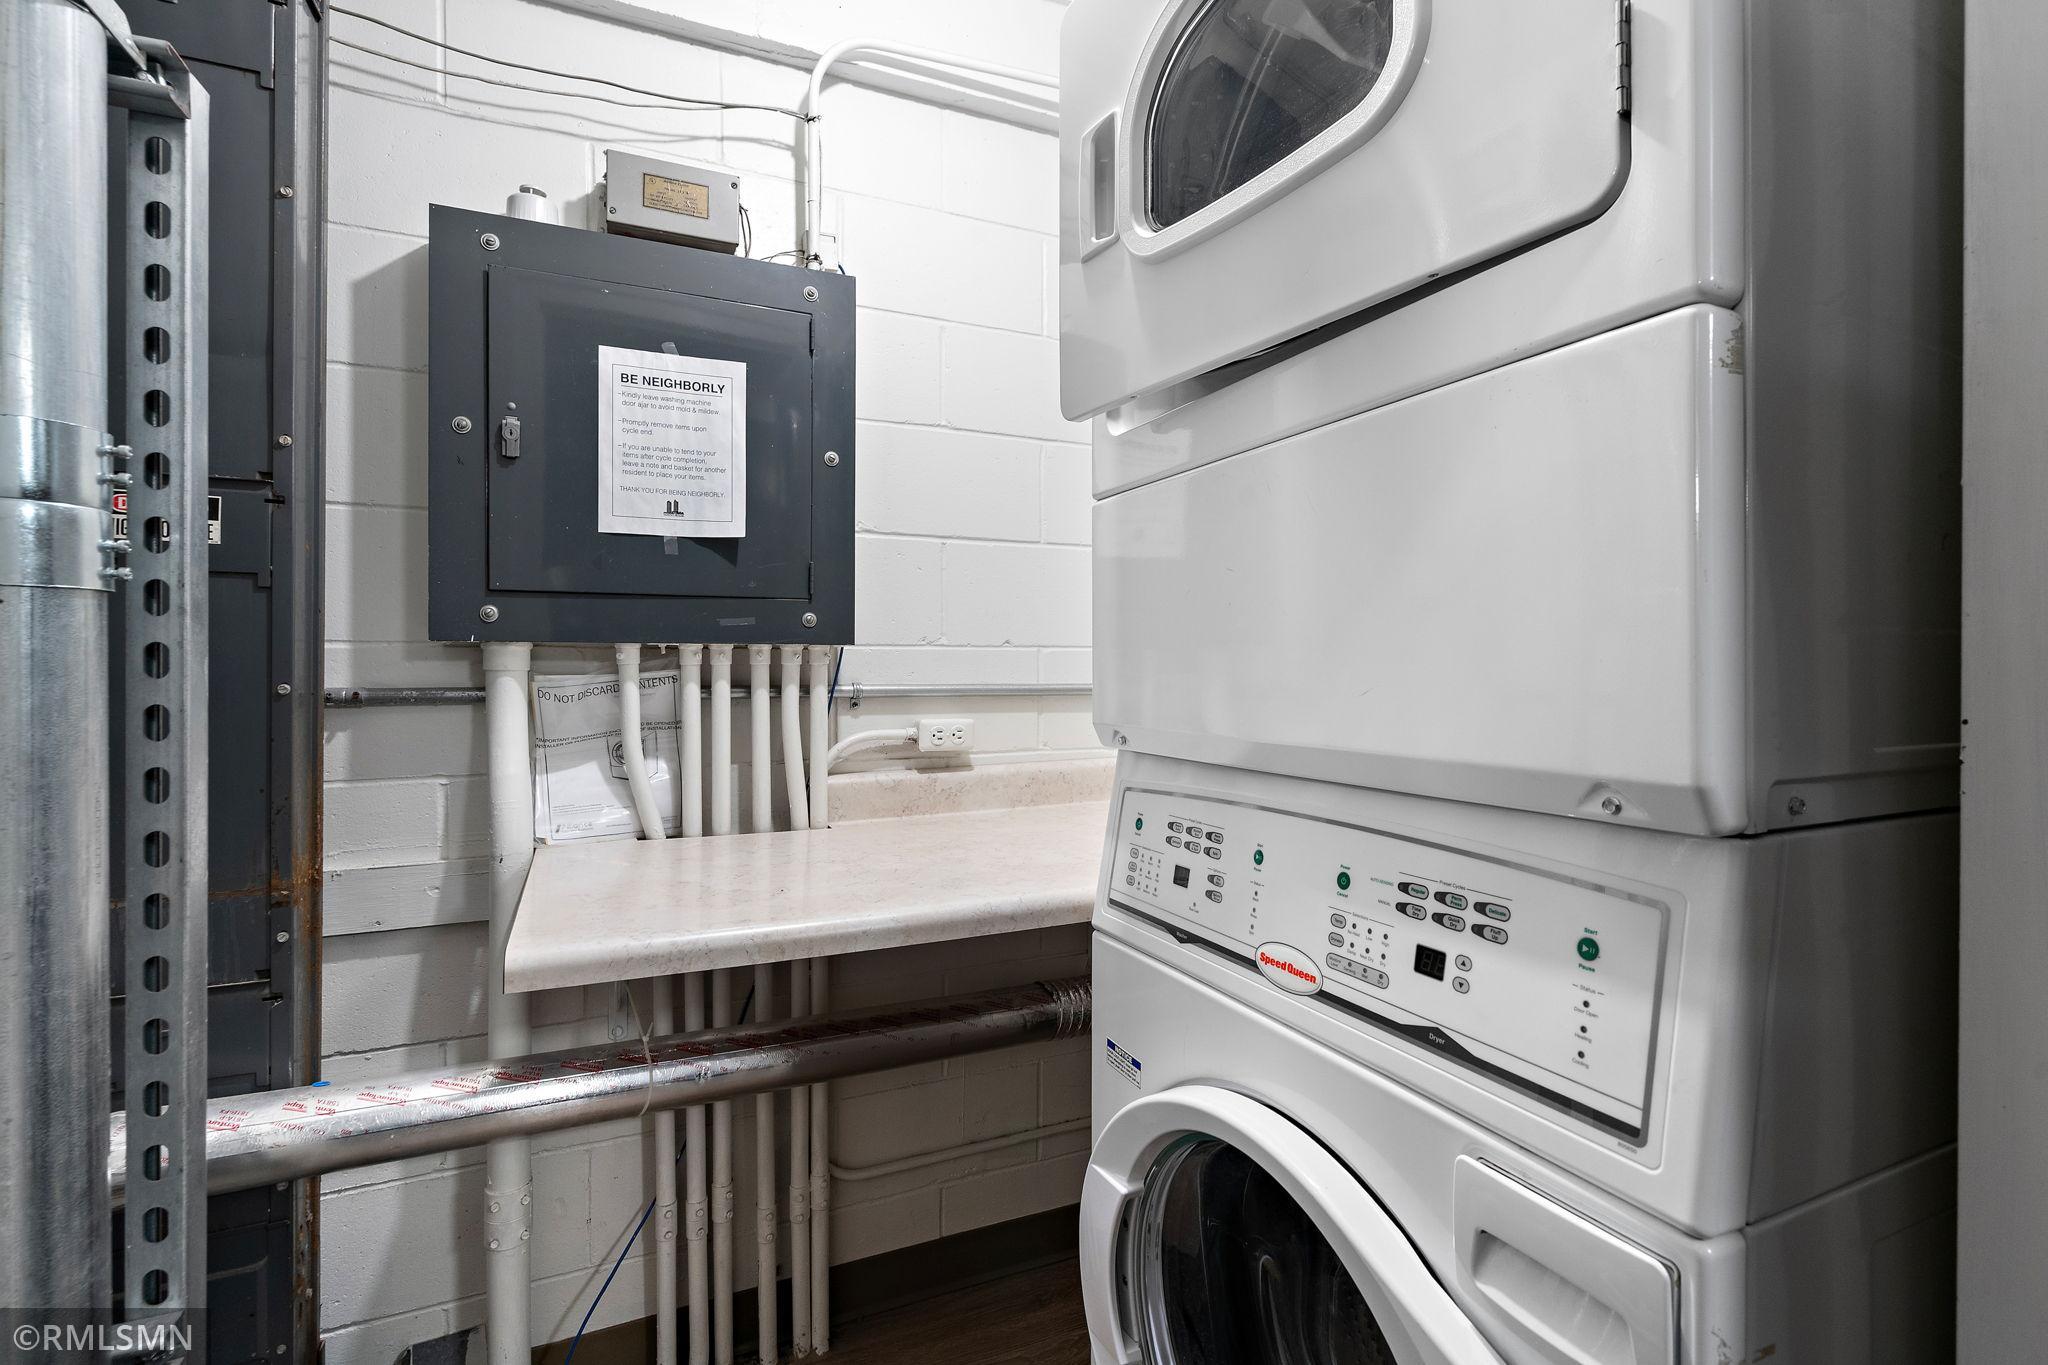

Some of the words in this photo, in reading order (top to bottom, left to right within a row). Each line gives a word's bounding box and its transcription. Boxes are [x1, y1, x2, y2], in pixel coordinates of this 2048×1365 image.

[620, 372, 639, 385] BE
[642, 375, 726, 395] NEIGHBORLY
[621, 400, 637, 408] door
[637, 402, 650, 410] ajar
[642, 393, 660, 401] leave
[660, 396, 685, 405] washing
[686, 399, 712, 407] machine
[621, 428, 639, 436] cycle
[650, 421, 673, 429] remove
[674, 423, 691, 431] items
[627, 444, 640, 452] you
[652, 446, 674, 454] unable
[681, 448, 696, 456] tend
[655, 455, 672, 463] cycle
[622, 460, 640, 468] leave
[673, 464, 695, 472] basket
[704, 467, 728, 475] another
[621, 469, 648, 477] resident
[656, 471, 674, 479] place
[674, 473, 688, 481] your
[619, 485, 641, 493] THANK
[537, 687, 551, 701] DO
[553, 692, 575, 704] NOT
[577, 683, 620, 701] DISCARD
[639, 674, 679, 690] NTENTS
[1439, 879, 1453, 888] Preset
[1452, 882, 1467, 892] Cycles
[1336, 890, 1349, 899] Cancel
[1488, 906, 1507, 918] Delicate
[1449, 921, 1458, 929] Dry
[1583, 927, 1599, 936] Start
[1491, 934, 1499, 942] Up
[1260, 951, 1288, 972] Speed
[1287, 963, 1317, 985] Queen
[1578, 962, 1596, 973] Pause
[1579, 984, 1597, 995] Status
[1573, 1005, 1586, 1014] Door
[1585, 1010, 1600, 1018] Open
[1428, 1032, 1446, 1045] Dryer
[1574, 1032, 1593, 1044] Heating
[1571, 1057, 1590, 1070] Cooling
